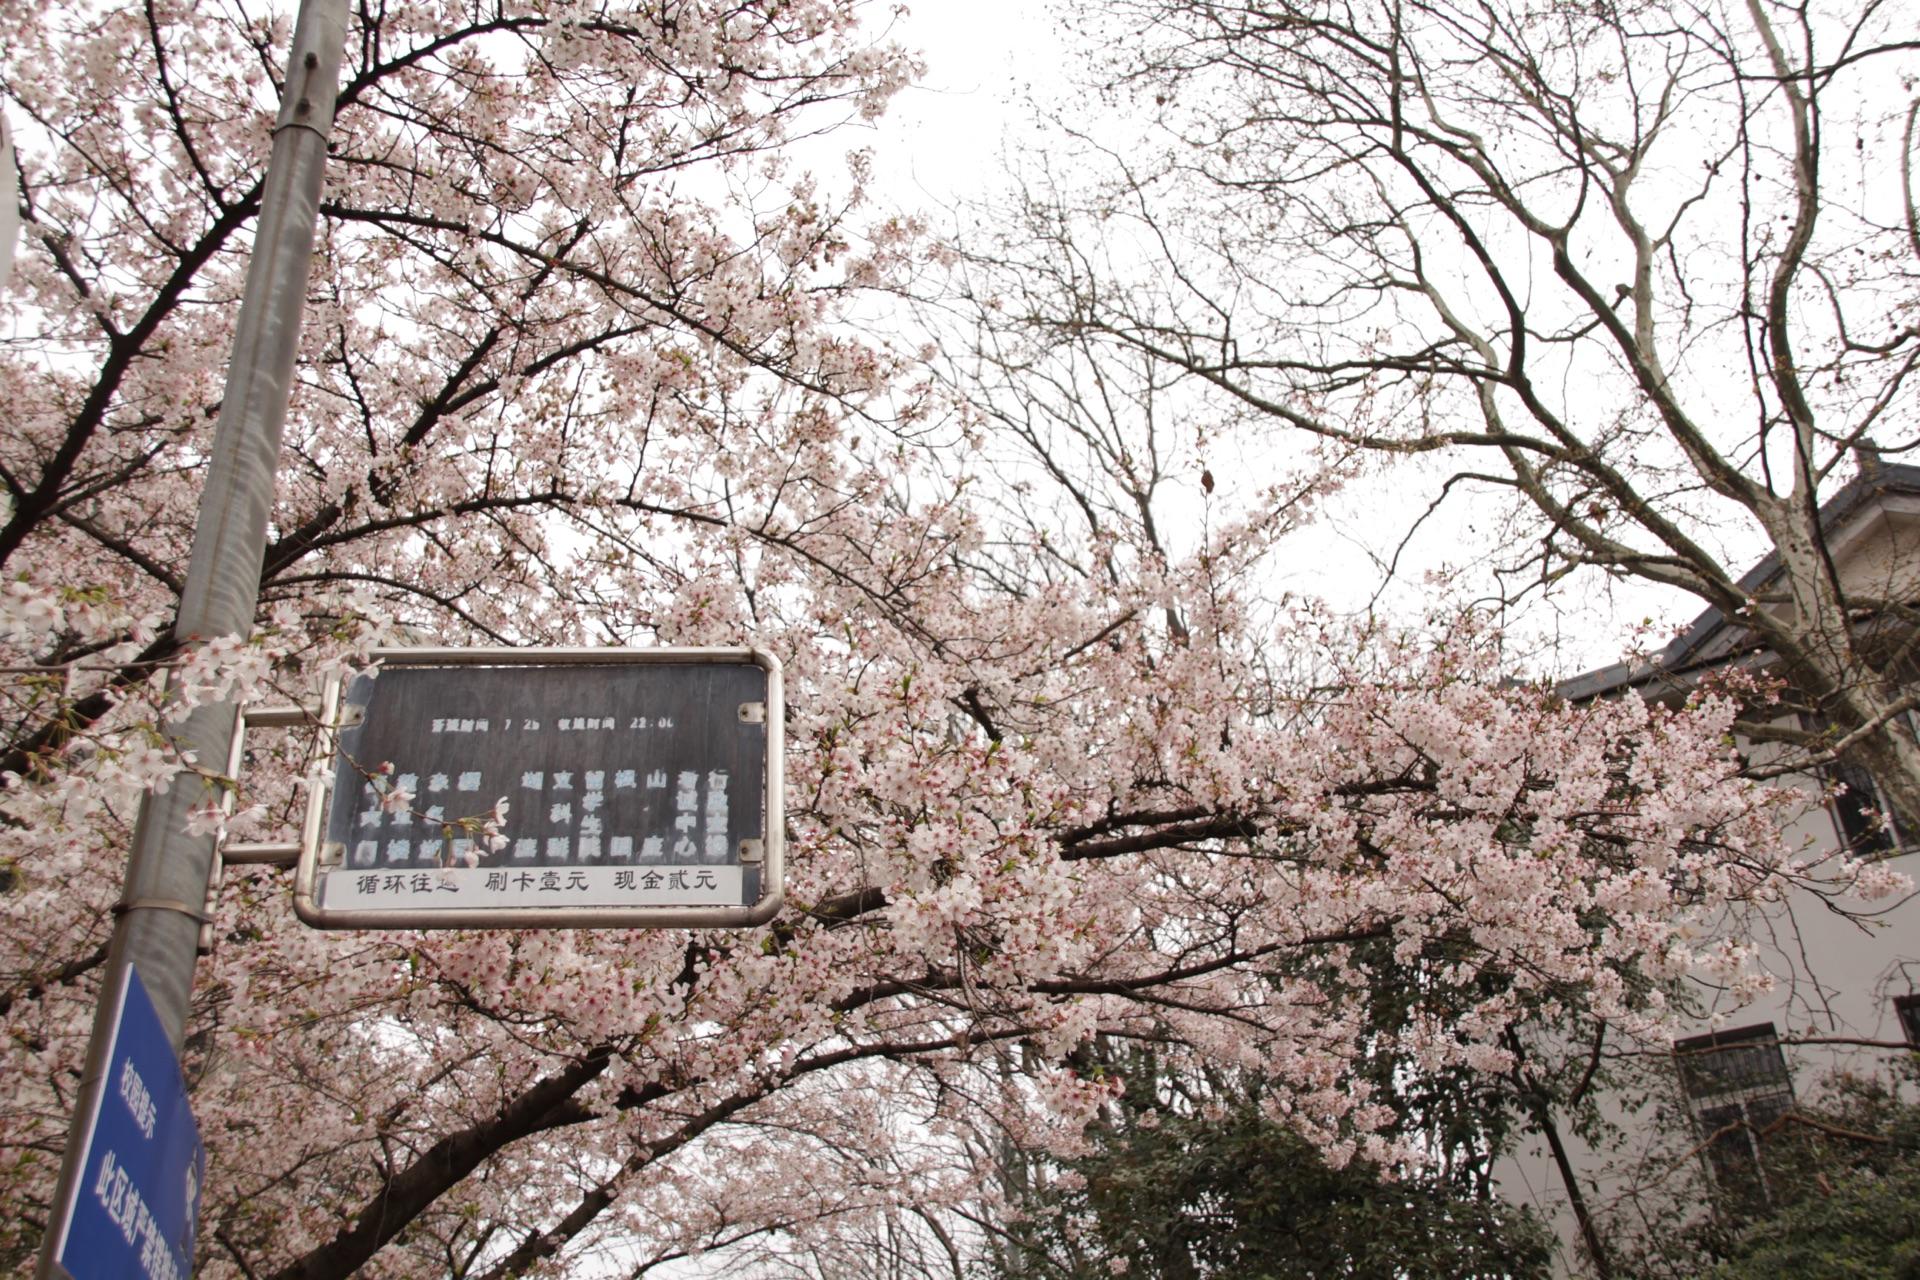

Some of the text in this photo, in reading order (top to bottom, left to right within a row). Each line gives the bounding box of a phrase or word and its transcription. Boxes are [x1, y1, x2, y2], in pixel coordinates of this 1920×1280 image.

[485, 871, 590, 893] 刷卡壹元
[613, 869, 718, 891] 现金贰元
